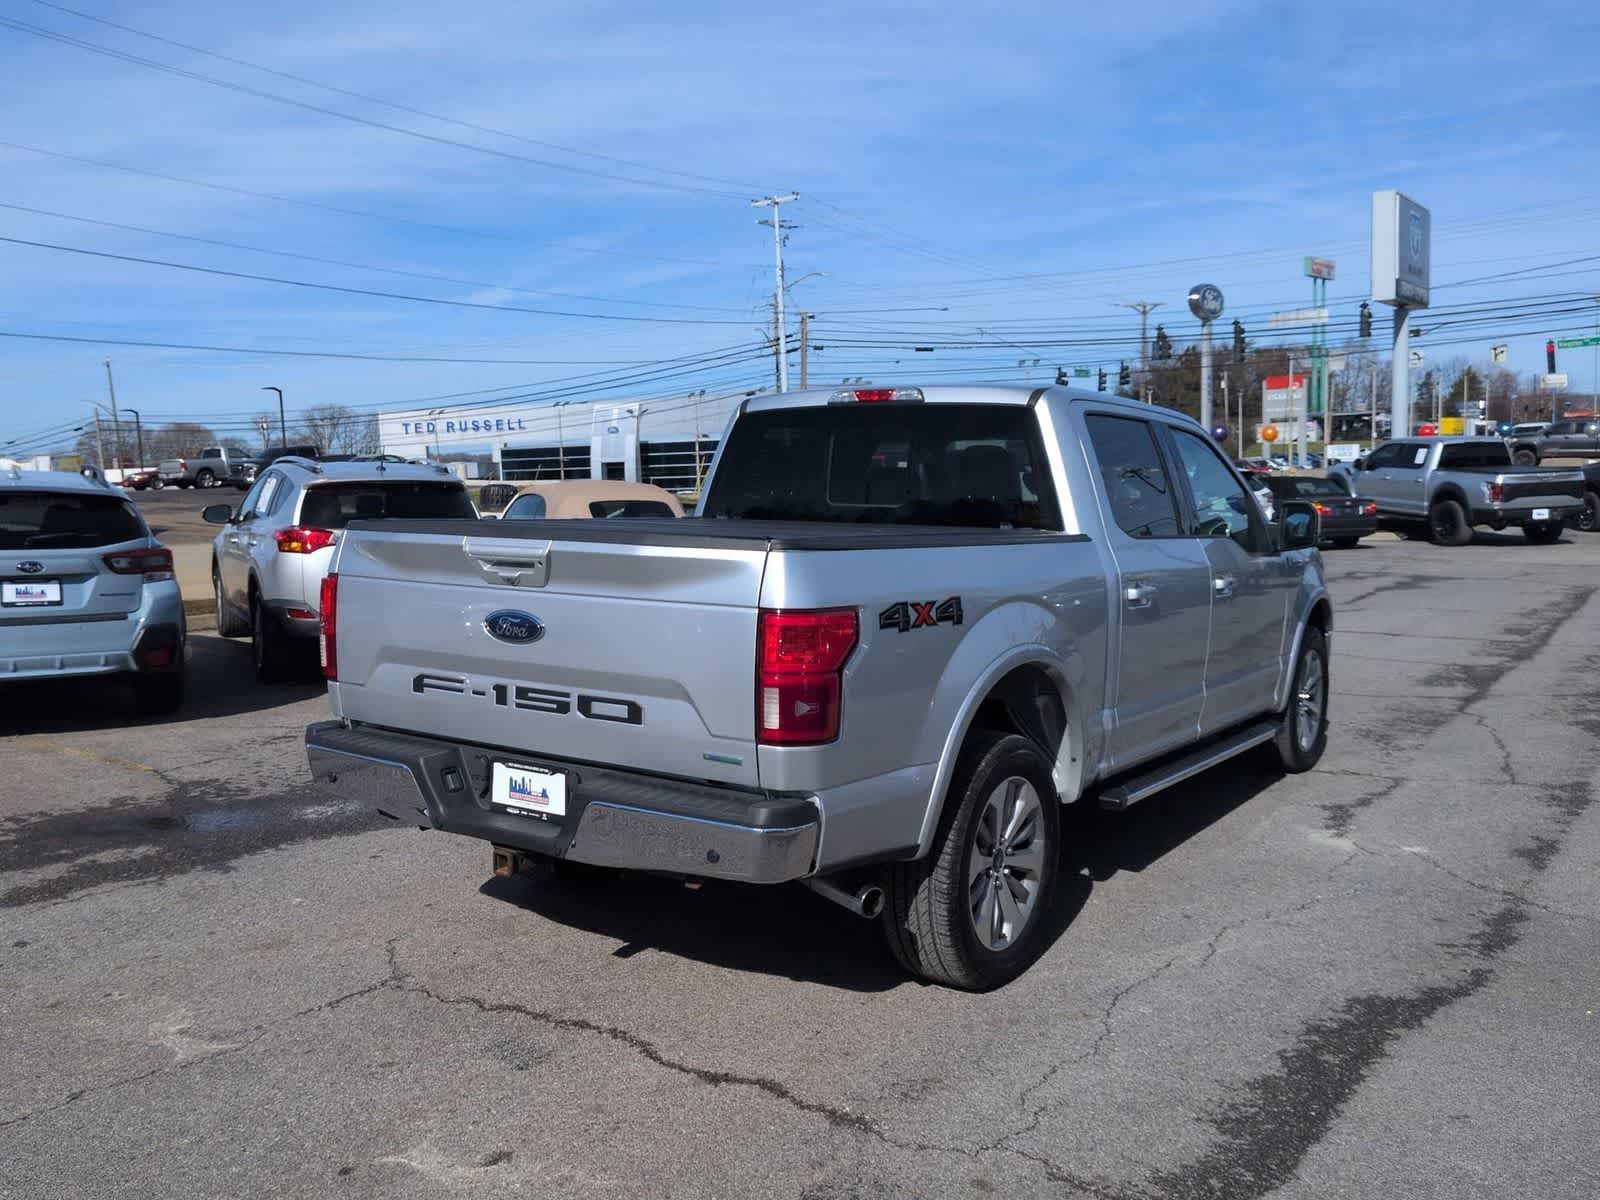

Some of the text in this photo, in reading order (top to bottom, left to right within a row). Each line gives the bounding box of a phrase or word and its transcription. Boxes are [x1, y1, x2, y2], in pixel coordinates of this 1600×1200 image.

[402, 417, 527, 435] TED RUSSELL
[495, 616, 530, 638] Ford
[411, 673, 645, 726] F-150
